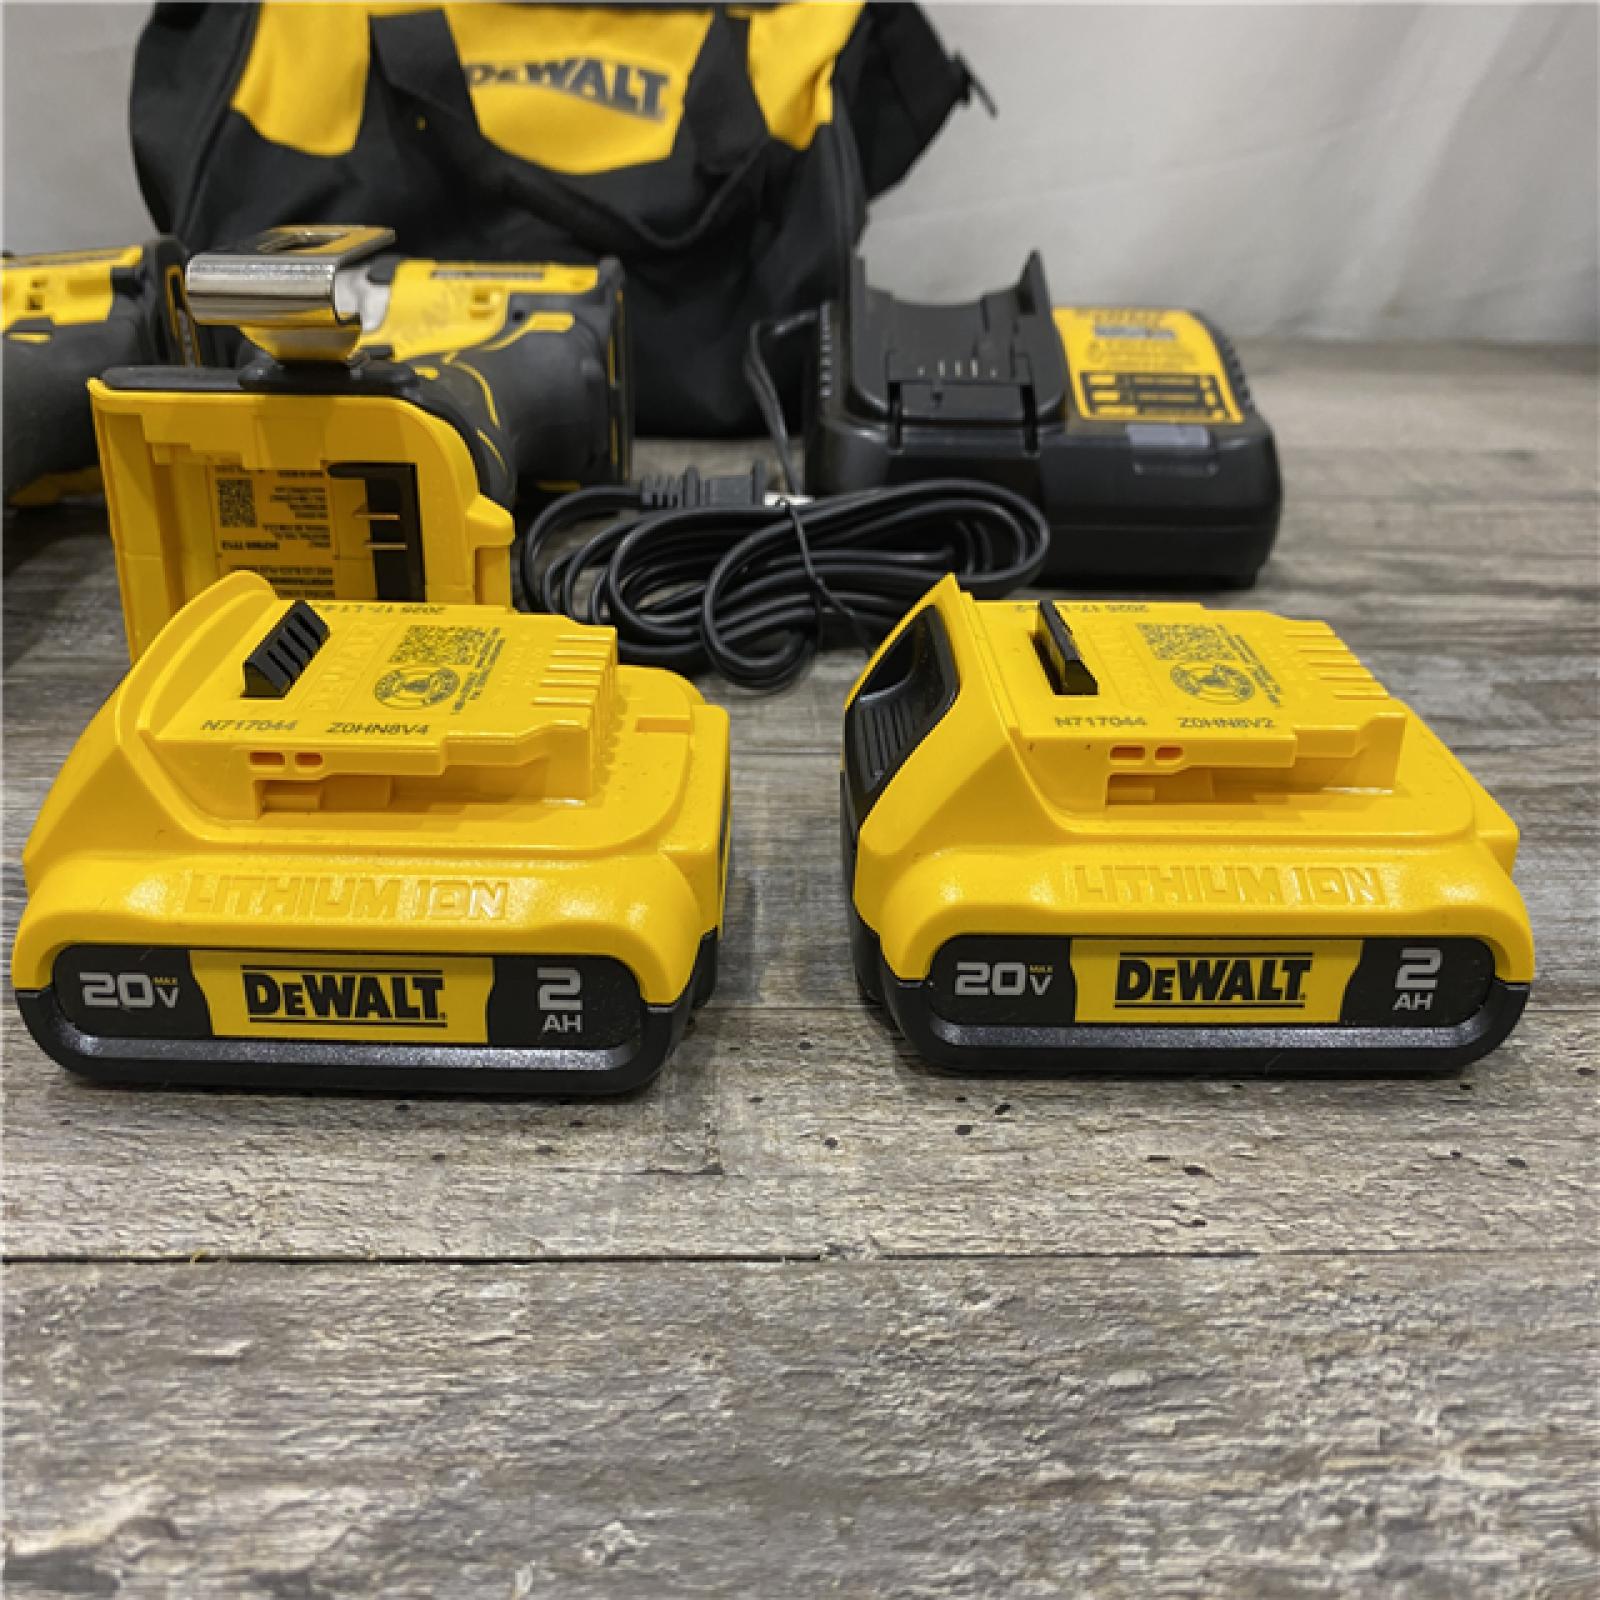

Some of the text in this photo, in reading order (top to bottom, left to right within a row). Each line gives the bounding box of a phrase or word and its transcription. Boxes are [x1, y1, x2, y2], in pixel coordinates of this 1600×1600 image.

[184, 872, 508, 921] LITHIUM ION
[1071, 863, 1387, 906] LITHIUM ION
[536, 966, 584, 1011] 2
[1394, 947, 1443, 990] 2
[1391, 991, 1434, 1011] AH
[541, 1013, 584, 1034] AH
